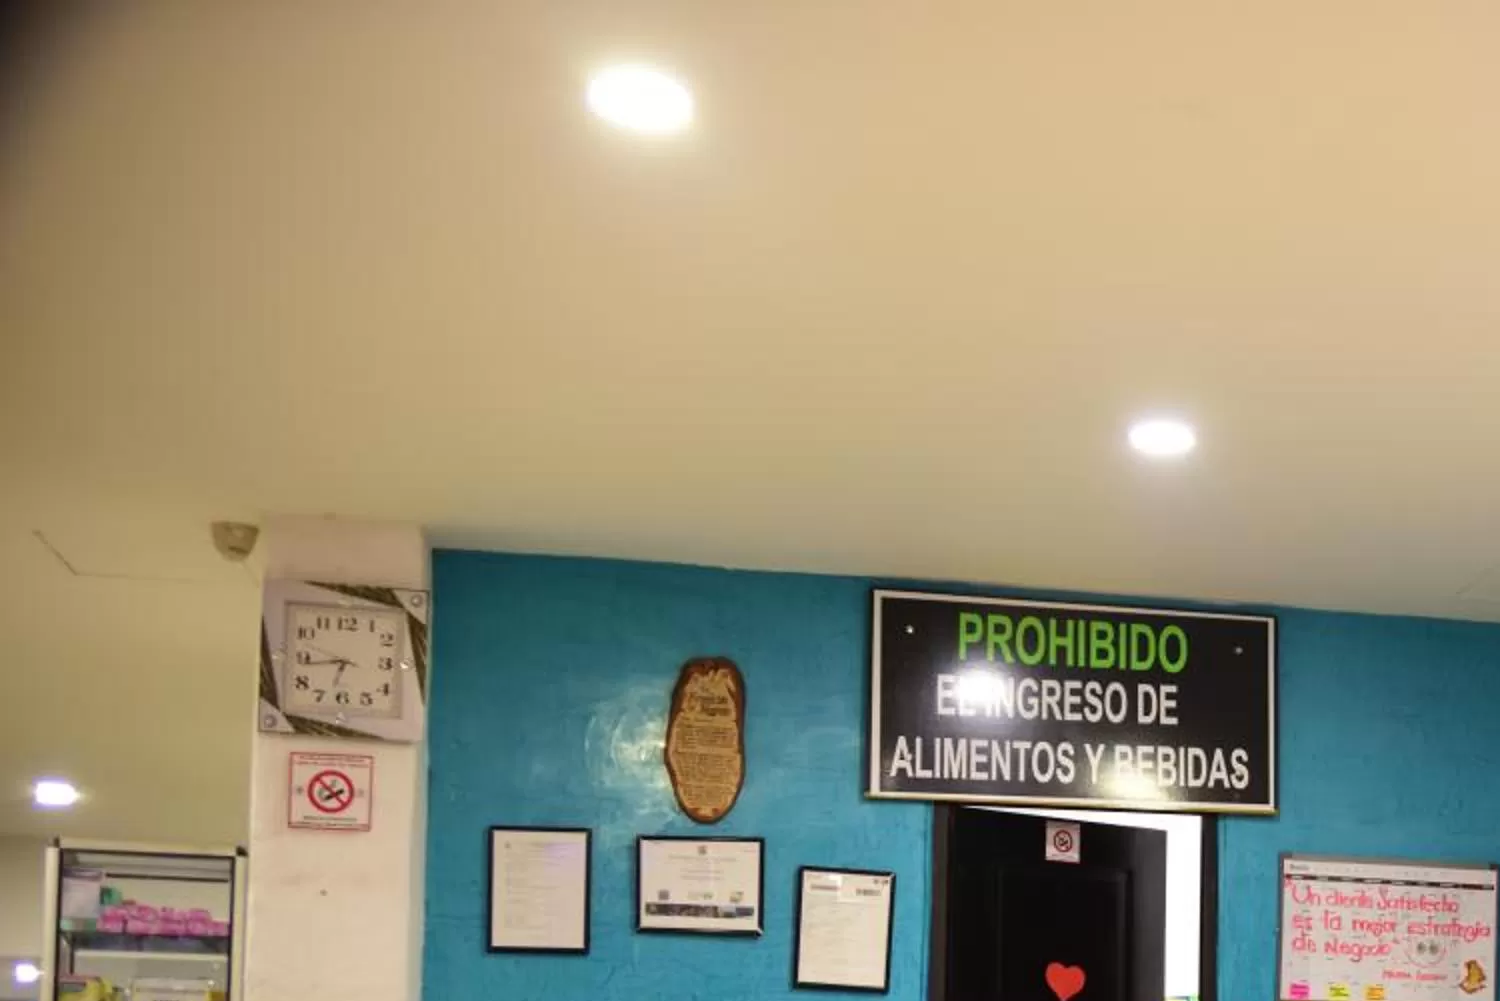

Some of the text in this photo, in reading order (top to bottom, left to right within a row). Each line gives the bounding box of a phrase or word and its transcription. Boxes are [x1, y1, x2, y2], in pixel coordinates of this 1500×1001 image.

[316, 616, 330, 631] 11
[337, 616, 358, 632] 12
[368, 619, 376, 632] 1
[297, 626, 315, 641] 10
[379, 632, 394, 647] 2
[958, 612, 1189, 674] PROHIBIDO
[296, 651, 312, 665] 9
[378, 657, 393, 670] 3
[295, 675, 310, 691] 8
[376, 683, 389, 696] 4
[313, 689, 325, 702] 7
[335, 691, 350, 705] 6
[360, 692, 374, 705] 5
[936, 674, 1179, 726] EL INGRESO DE
[889, 734, 1250, 789] ALIMENTOS Y BEBIDAS
[1351, 918, 1397, 937] mejor
[1407, 915, 1491, 942] estrategia
